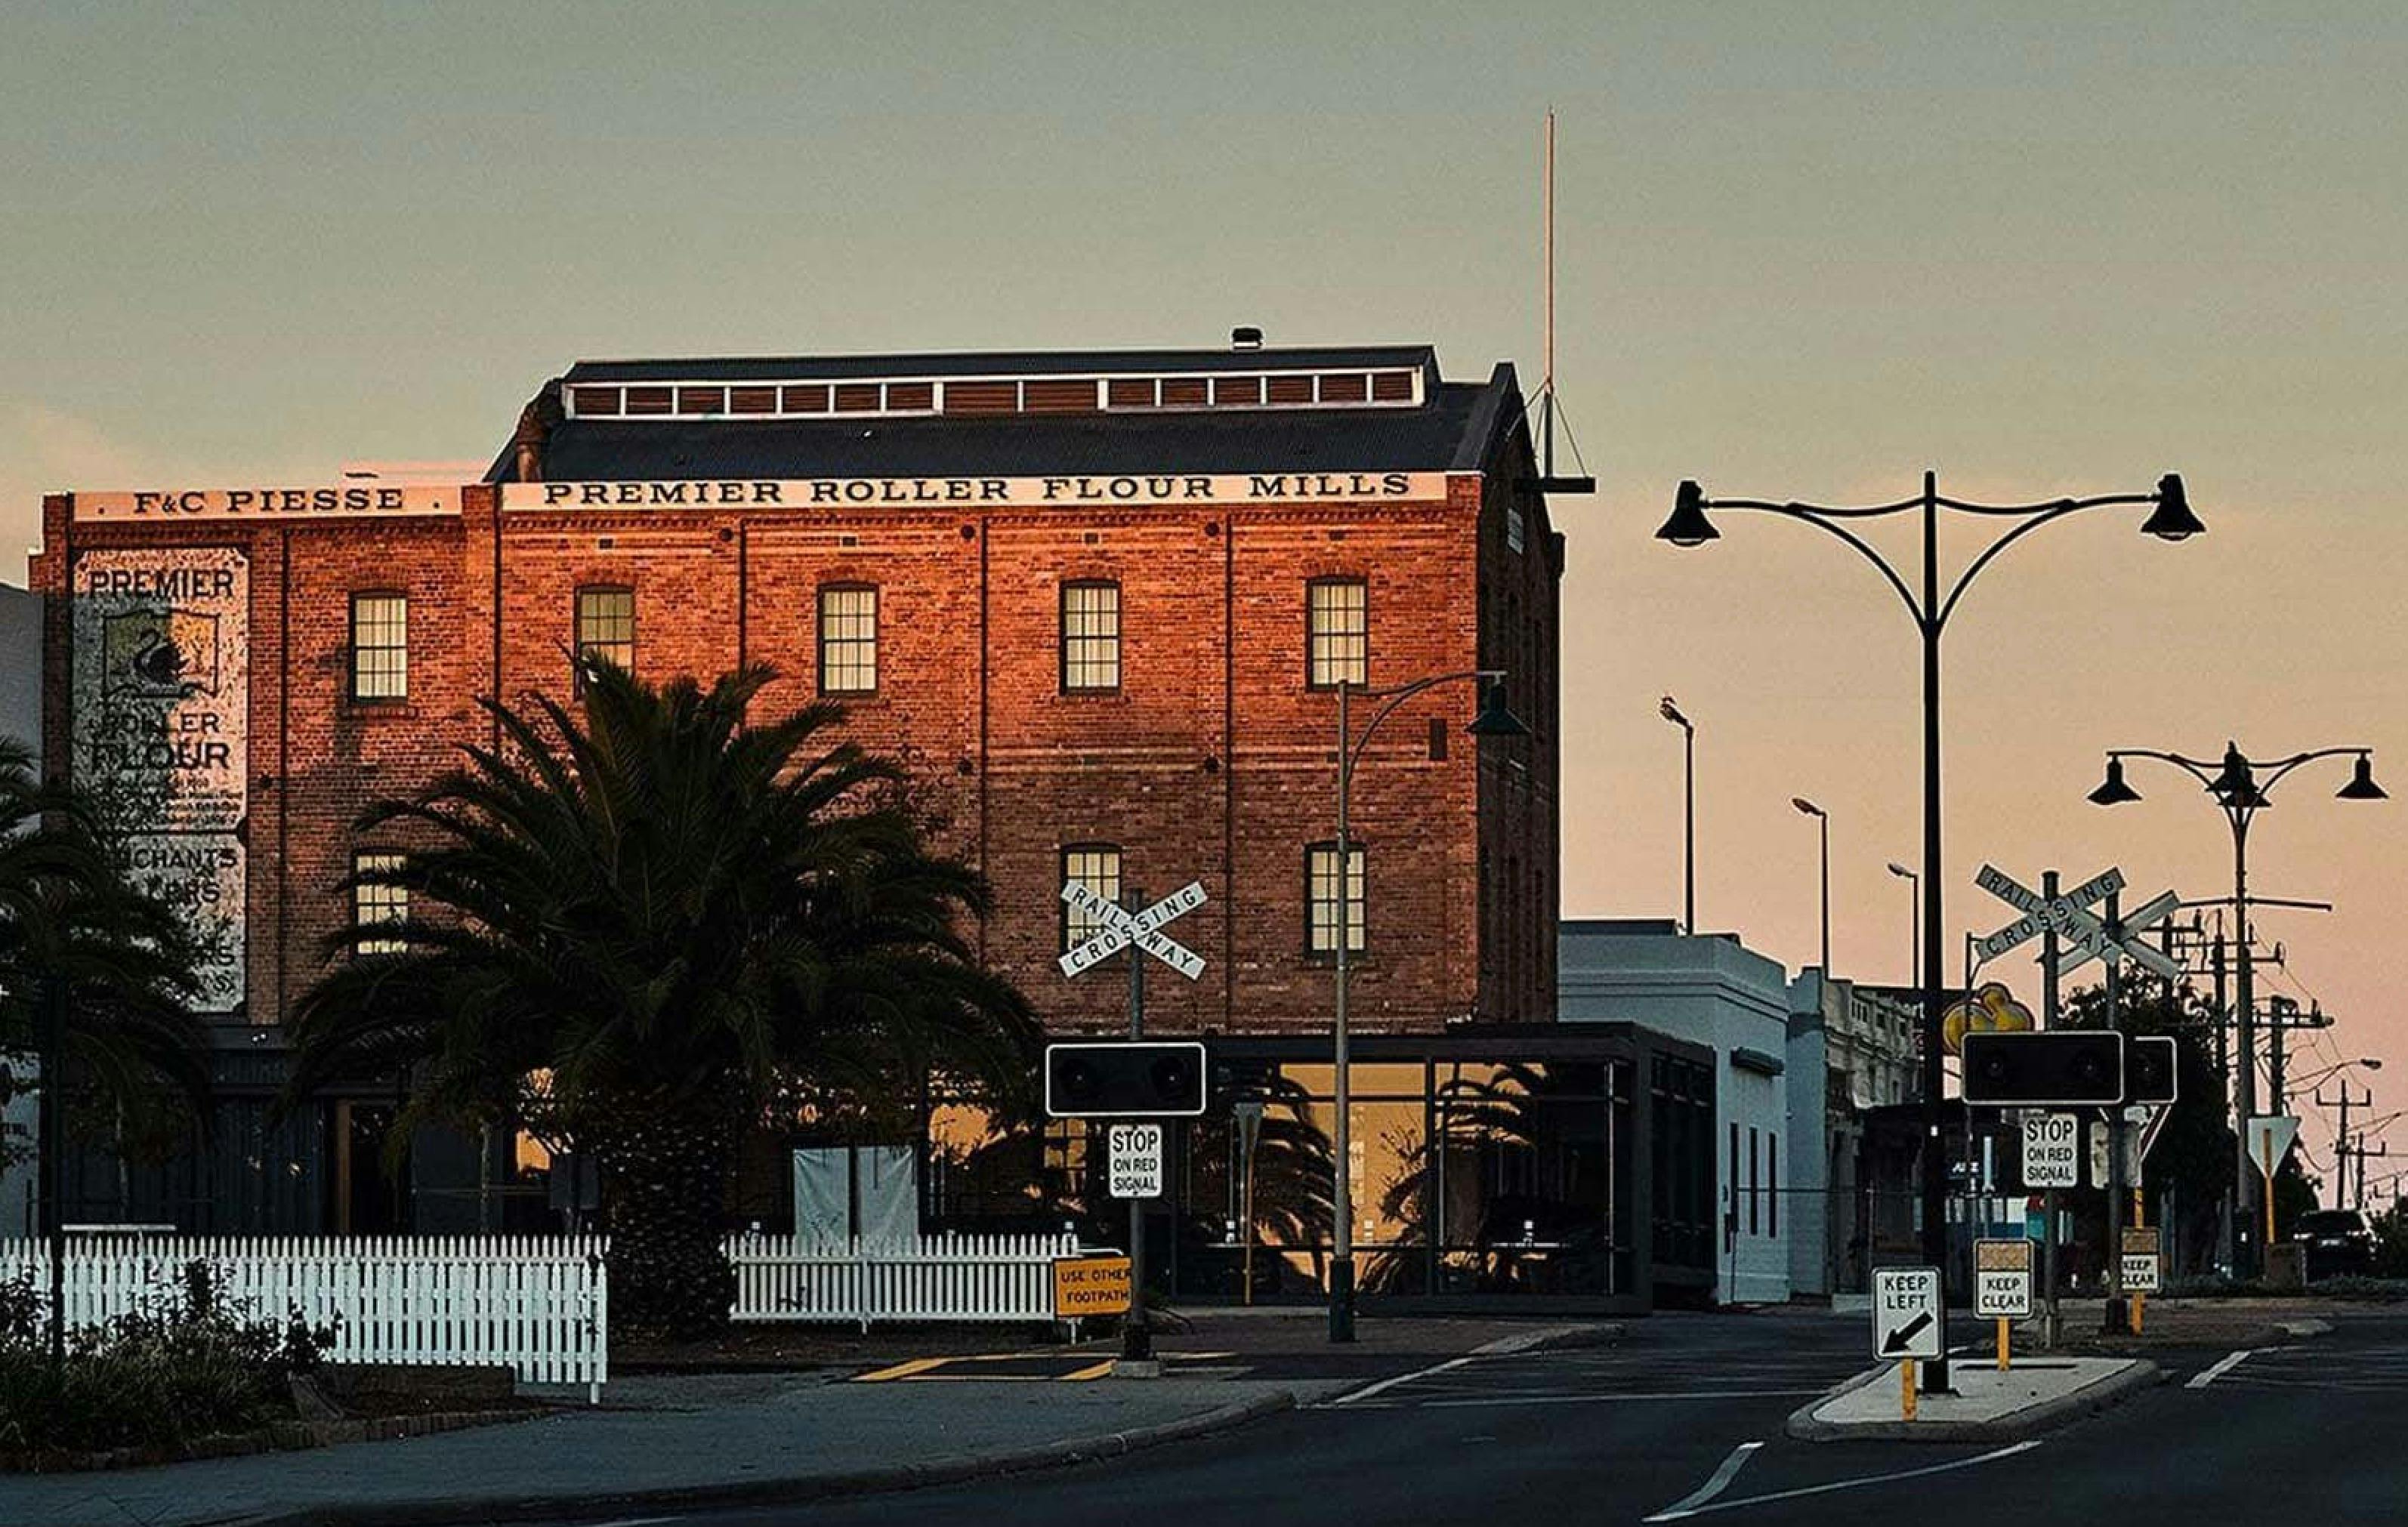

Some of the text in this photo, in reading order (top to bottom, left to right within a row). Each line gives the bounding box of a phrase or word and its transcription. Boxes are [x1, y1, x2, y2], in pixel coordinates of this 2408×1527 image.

[544, 474, 1410, 504] PREMIER ROLLER FLOUR MILLS
[133, 488, 403, 514] F&C PIESSE
[88, 569, 234, 600] PREMIER
[92, 742, 230, 770] FLOUR
[1986, 877, 2115, 954] CROSSING
[1070, 890, 1196, 967] CROSSING
[1072, 887, 1194, 968] RAILWAY
[2027, 1119, 2073, 1141] STOP
[1112, 1131, 1159, 1153] STOP
[2027, 1147, 2073, 1161] ON RED
[1113, 1158, 1158, 1172] ON RED
[2027, 1165, 2073, 1180] SIGNAL
[1113, 1176, 1158, 1192] SIGNAL
[1061, 1269, 1132, 1282] USE OTHER
[1885, 1276, 1928, 1291] KEEP
[1987, 1278, 2021, 1291] KEEP
[1067, 1289, 1128, 1303] FOOTPATH
[1886, 1294, 1927, 1310] LEFT
[1981, 1294, 2025, 1310] CLEAR
